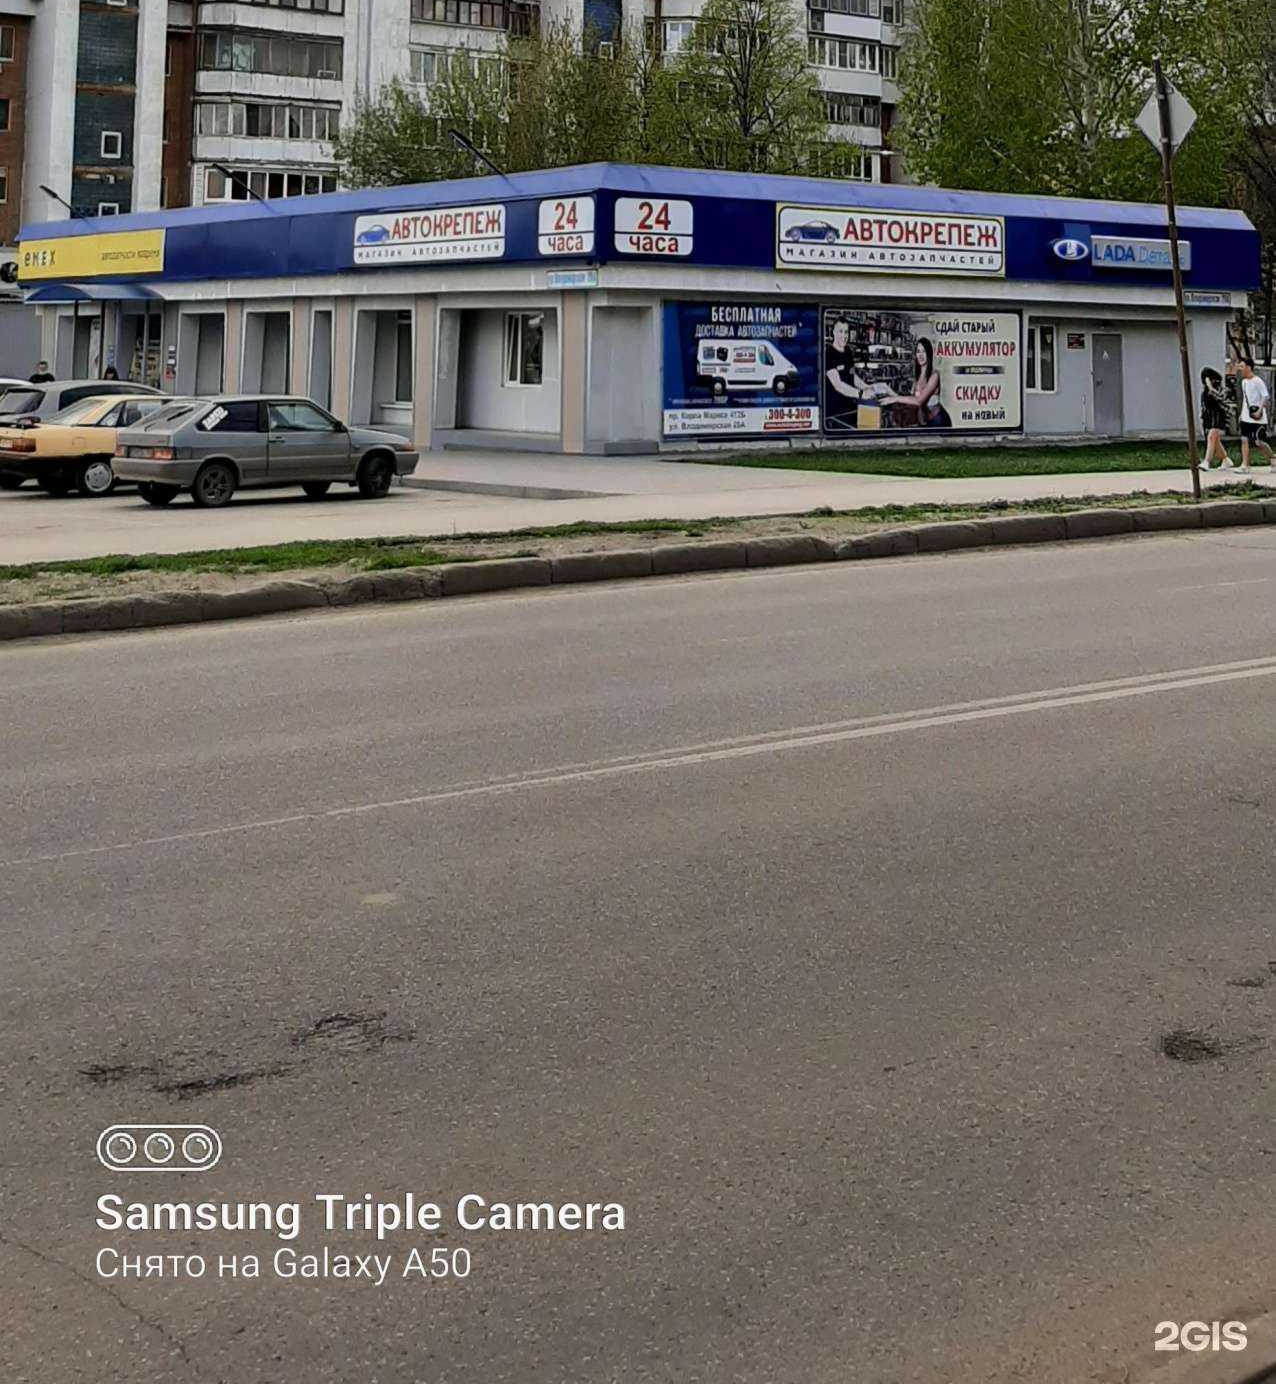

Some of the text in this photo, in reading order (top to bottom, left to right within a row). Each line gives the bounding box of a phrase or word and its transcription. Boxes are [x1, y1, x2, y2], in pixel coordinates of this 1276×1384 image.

[392, 209, 502, 240] АВТОКРЕПЕЖ
[554, 201, 578, 231] 24
[638, 202, 671, 231] 24
[843, 217, 998, 247] АВТОКРЕПЕЖ
[547, 235, 584, 252] часа
[629, 235, 679, 253] часа
[786, 248, 994, 265] МАГАЗИН АВТОЗАПЧАСТЕЙ
[1094, 244, 1136, 262] LADA
[711, 306, 782, 322] БЕСПЛАТНАЯ
[694, 324, 735, 337] ДОСТАВКА
[936, 318, 996, 335] СДАЙ СТАРЫЙ
[936, 341, 1016, 356] АККУМУЛЯТОР
[955, 385, 1001, 405] СКИДКУ
[961, 407, 1006, 420] на новый
